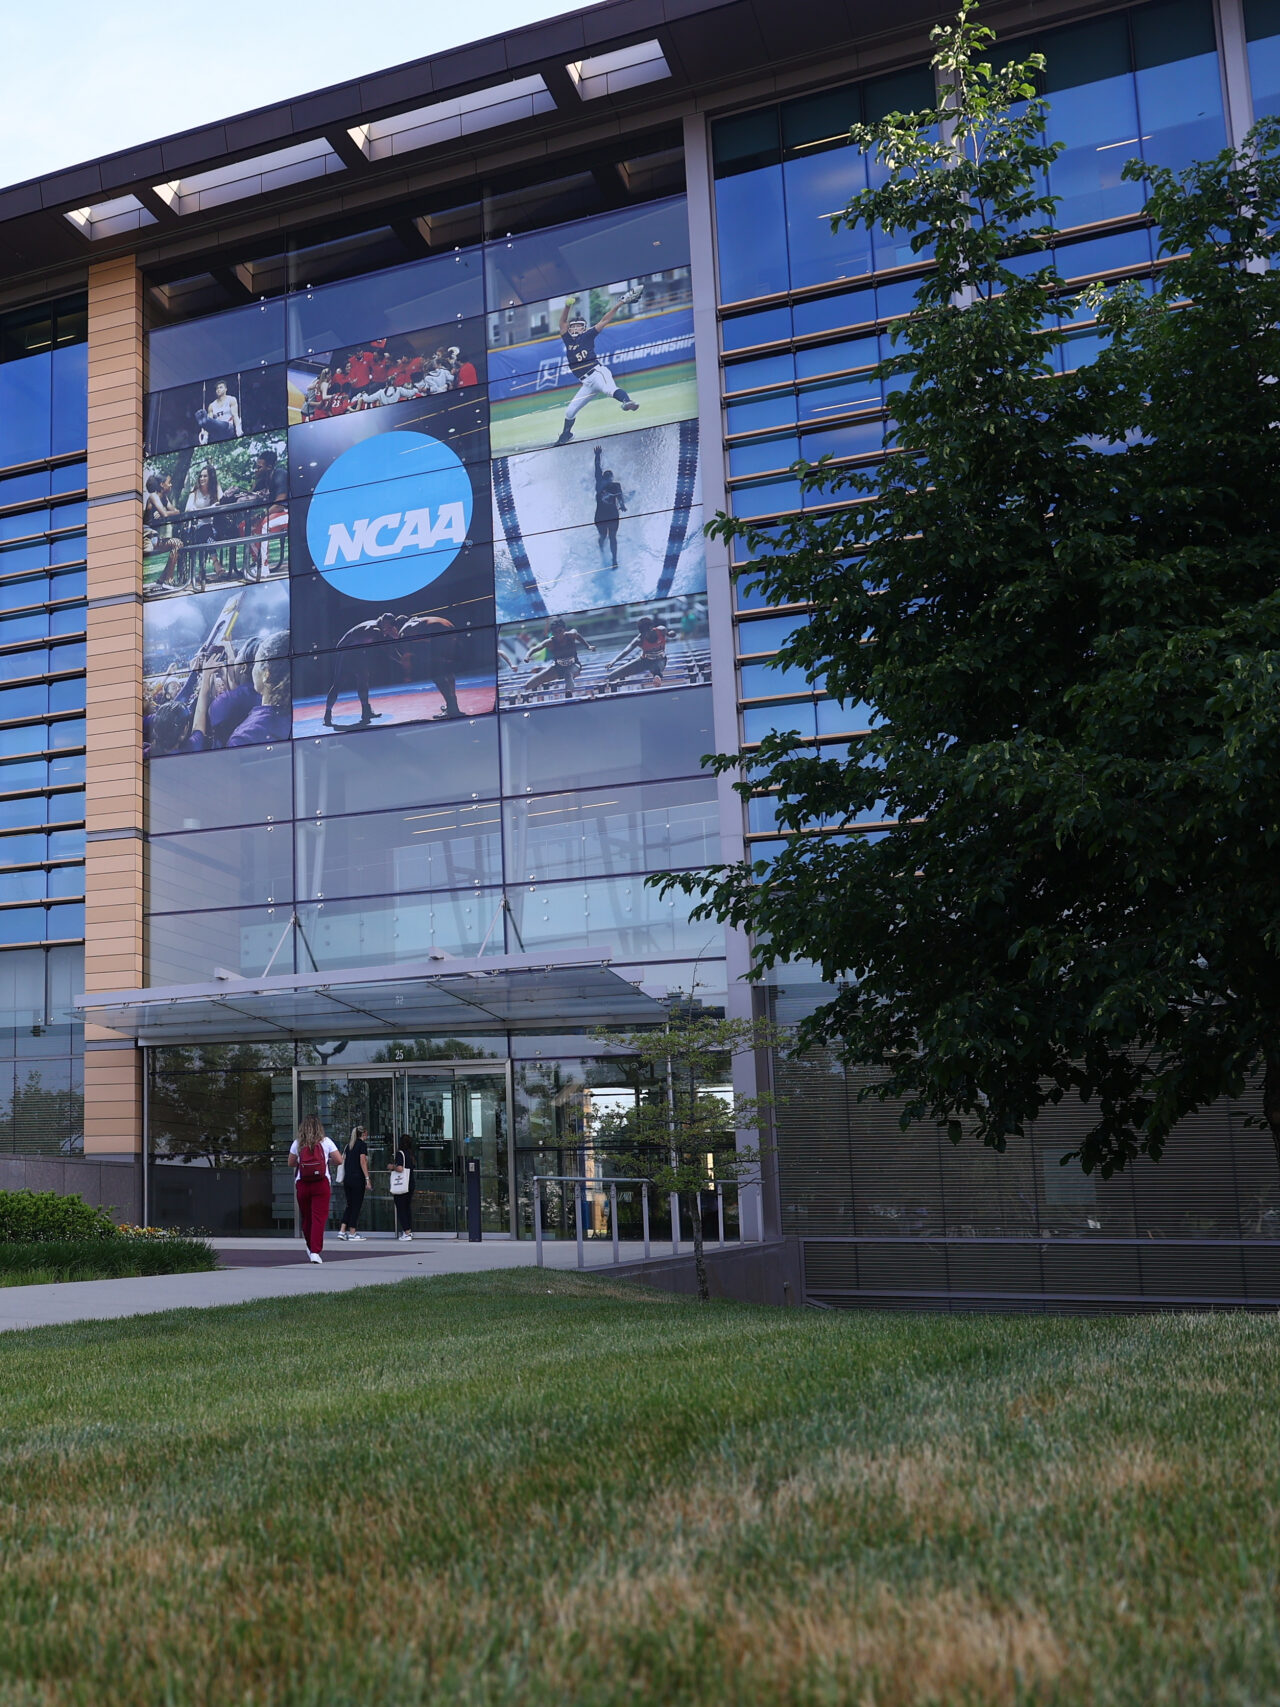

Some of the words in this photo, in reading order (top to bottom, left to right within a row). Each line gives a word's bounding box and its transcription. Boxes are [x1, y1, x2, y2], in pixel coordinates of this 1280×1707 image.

[576, 349, 588, 362] 50
[324, 501, 466, 566] NCAA
[395, 1049, 404, 1060] 25
